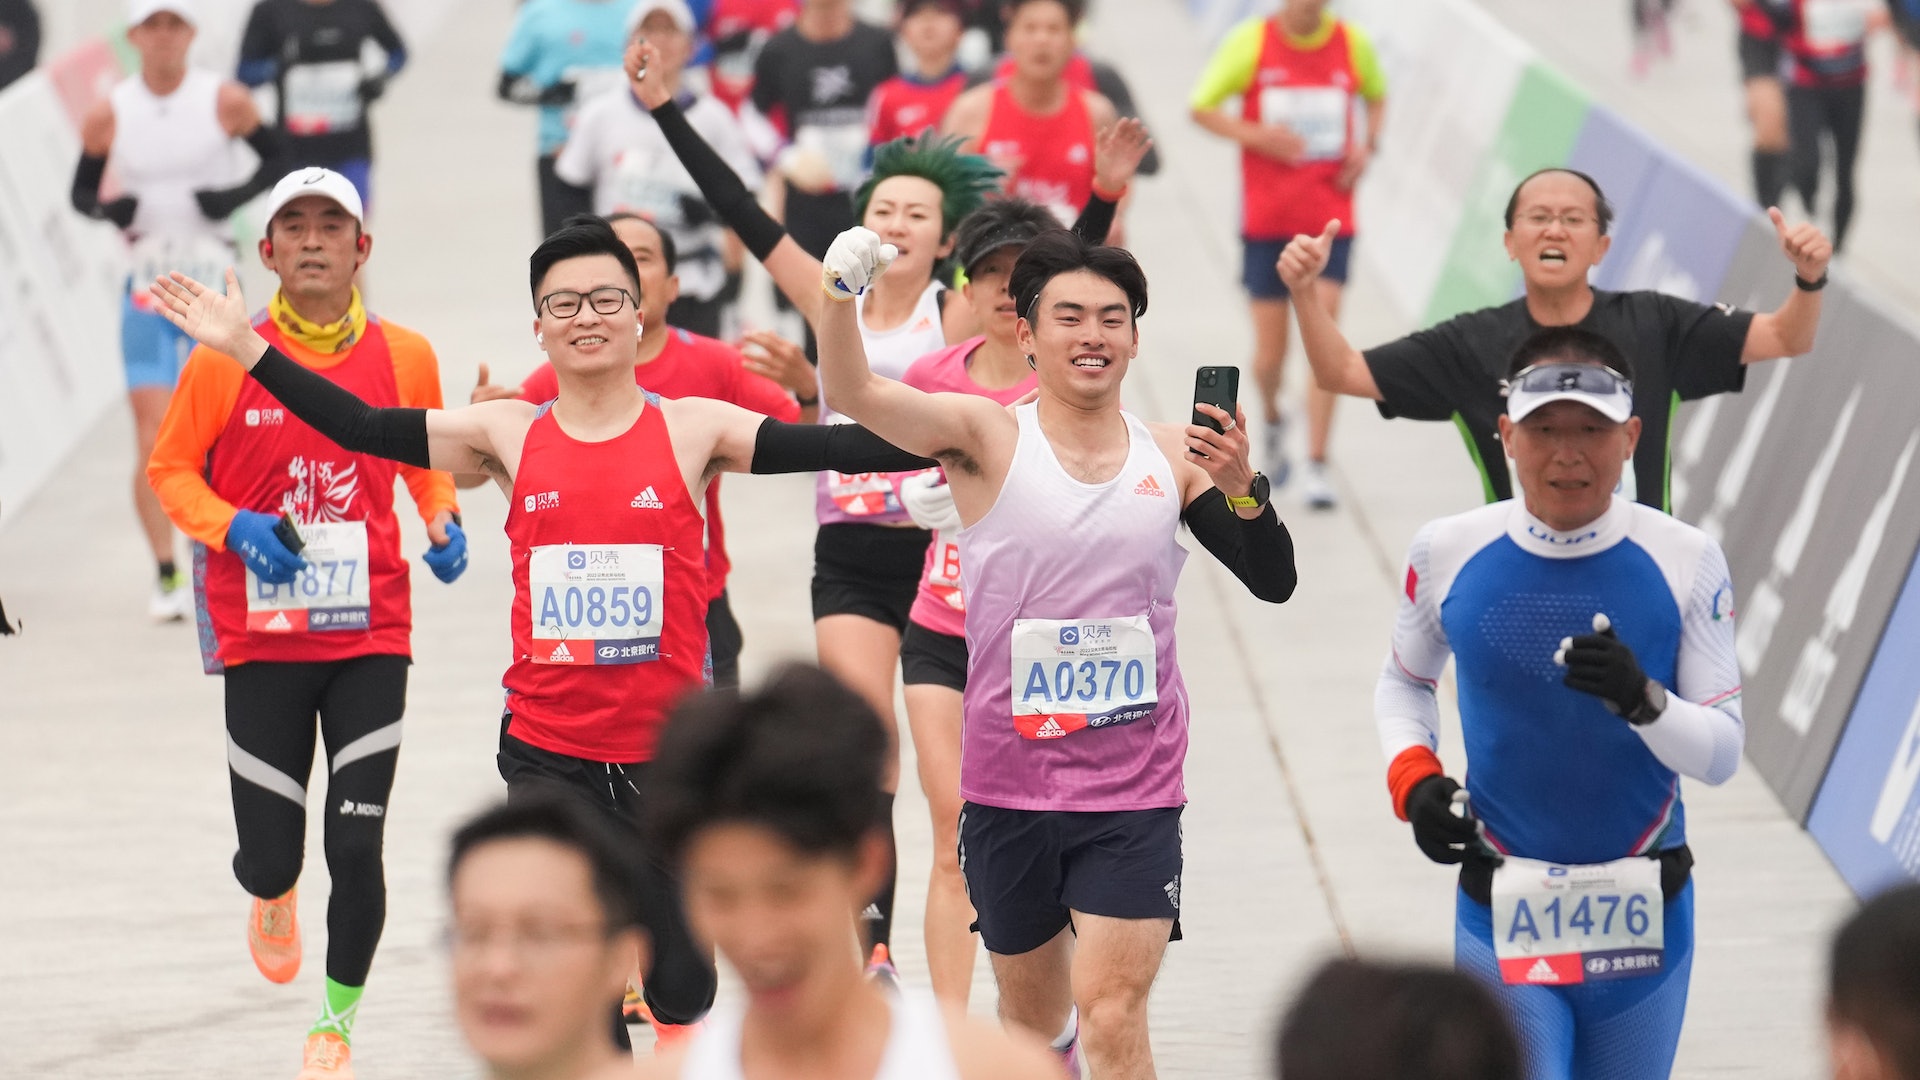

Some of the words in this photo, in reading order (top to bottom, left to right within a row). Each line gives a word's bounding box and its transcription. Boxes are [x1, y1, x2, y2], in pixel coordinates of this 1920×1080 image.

[537, 491, 560, 505] 贝壳
[1134, 487, 1165, 498] adidas
[630, 500, 664, 510] adidas
[590, 550, 619, 565] 贝壳
[540, 585, 653, 628] A0859
[1082, 624, 1112, 640] 贝壳
[620, 643, 656, 658] 北京现代
[549, 655, 575, 663] adidas
[1021, 658, 1145, 703] A0370
[1035, 729, 1067, 738] adidas
[1507, 893, 1650, 943] A1476
